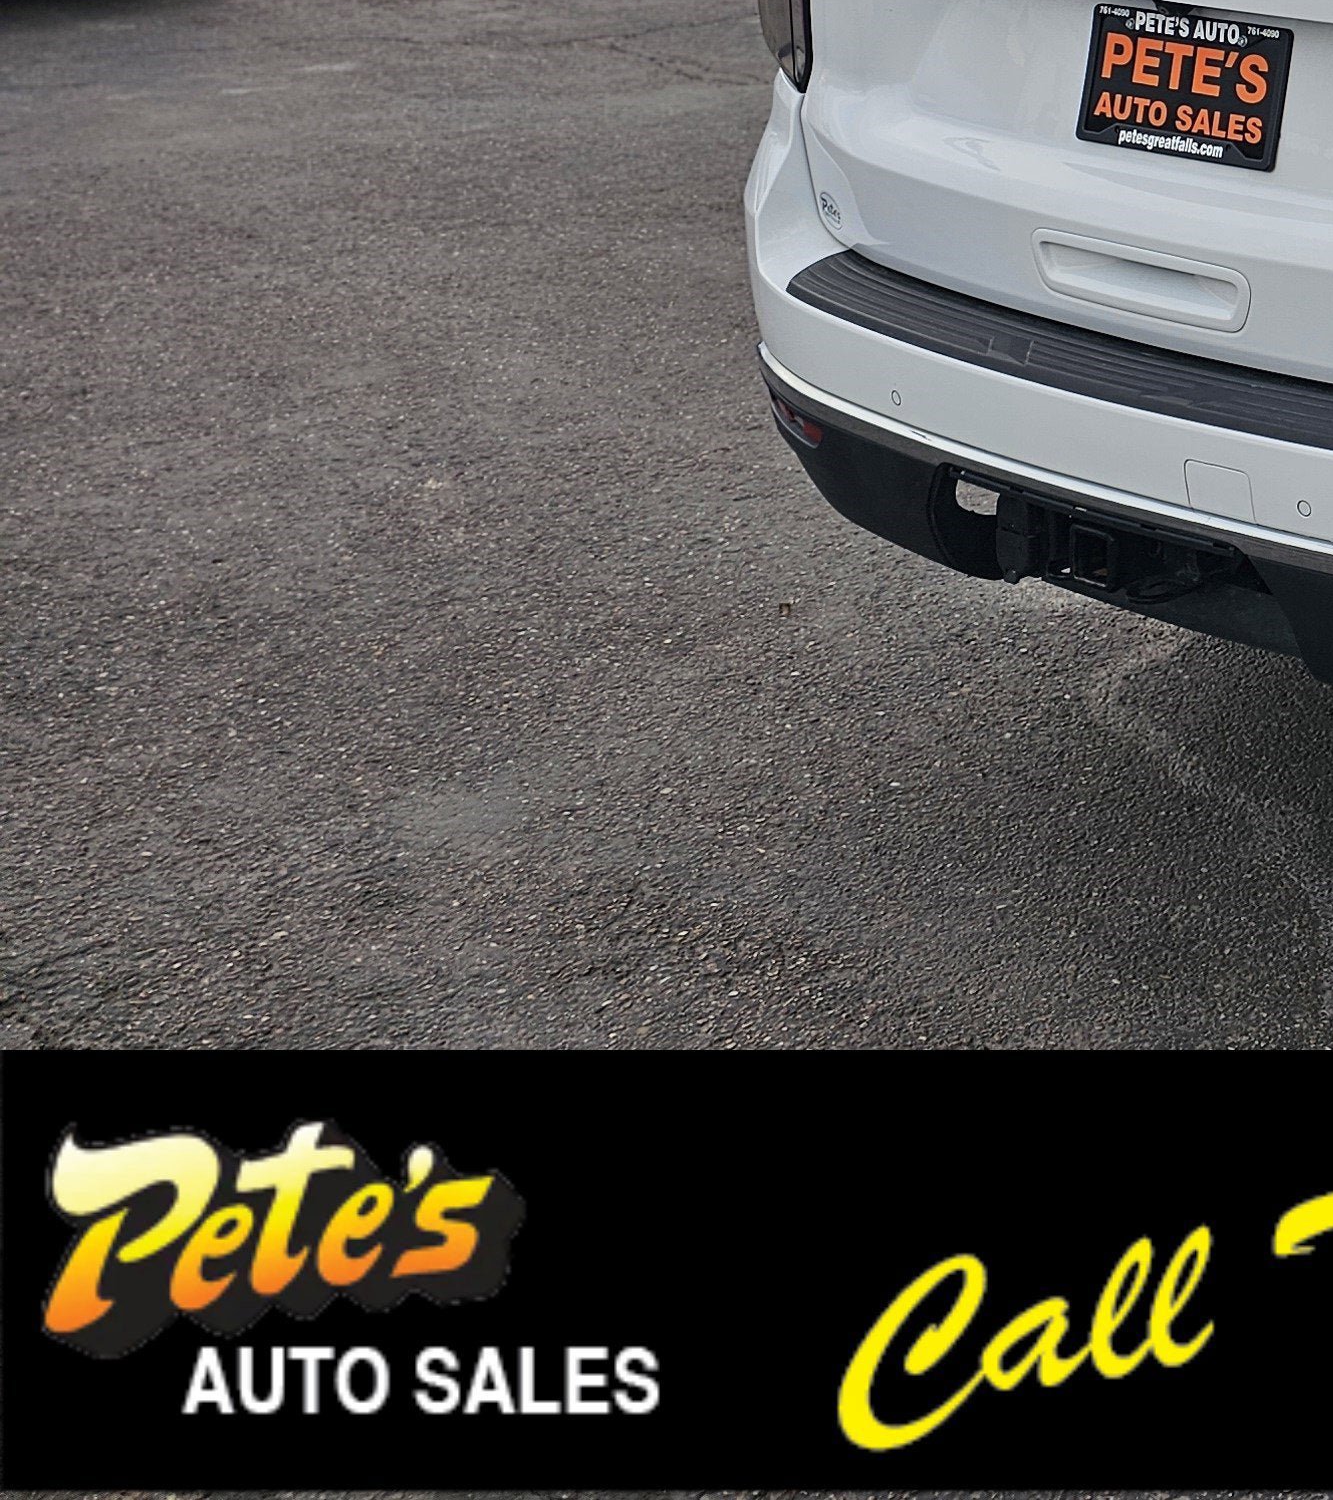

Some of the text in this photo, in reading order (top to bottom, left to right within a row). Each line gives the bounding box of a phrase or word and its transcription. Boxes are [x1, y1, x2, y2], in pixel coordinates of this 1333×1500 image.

[1134, 10, 1240, 45] PETE'S AUTO
[1100, 31, 1270, 105] PETE'S
[1093, 92, 1263, 144] AUTO SALES
[1117, 128, 1224, 159] petesgreatfalls.com
